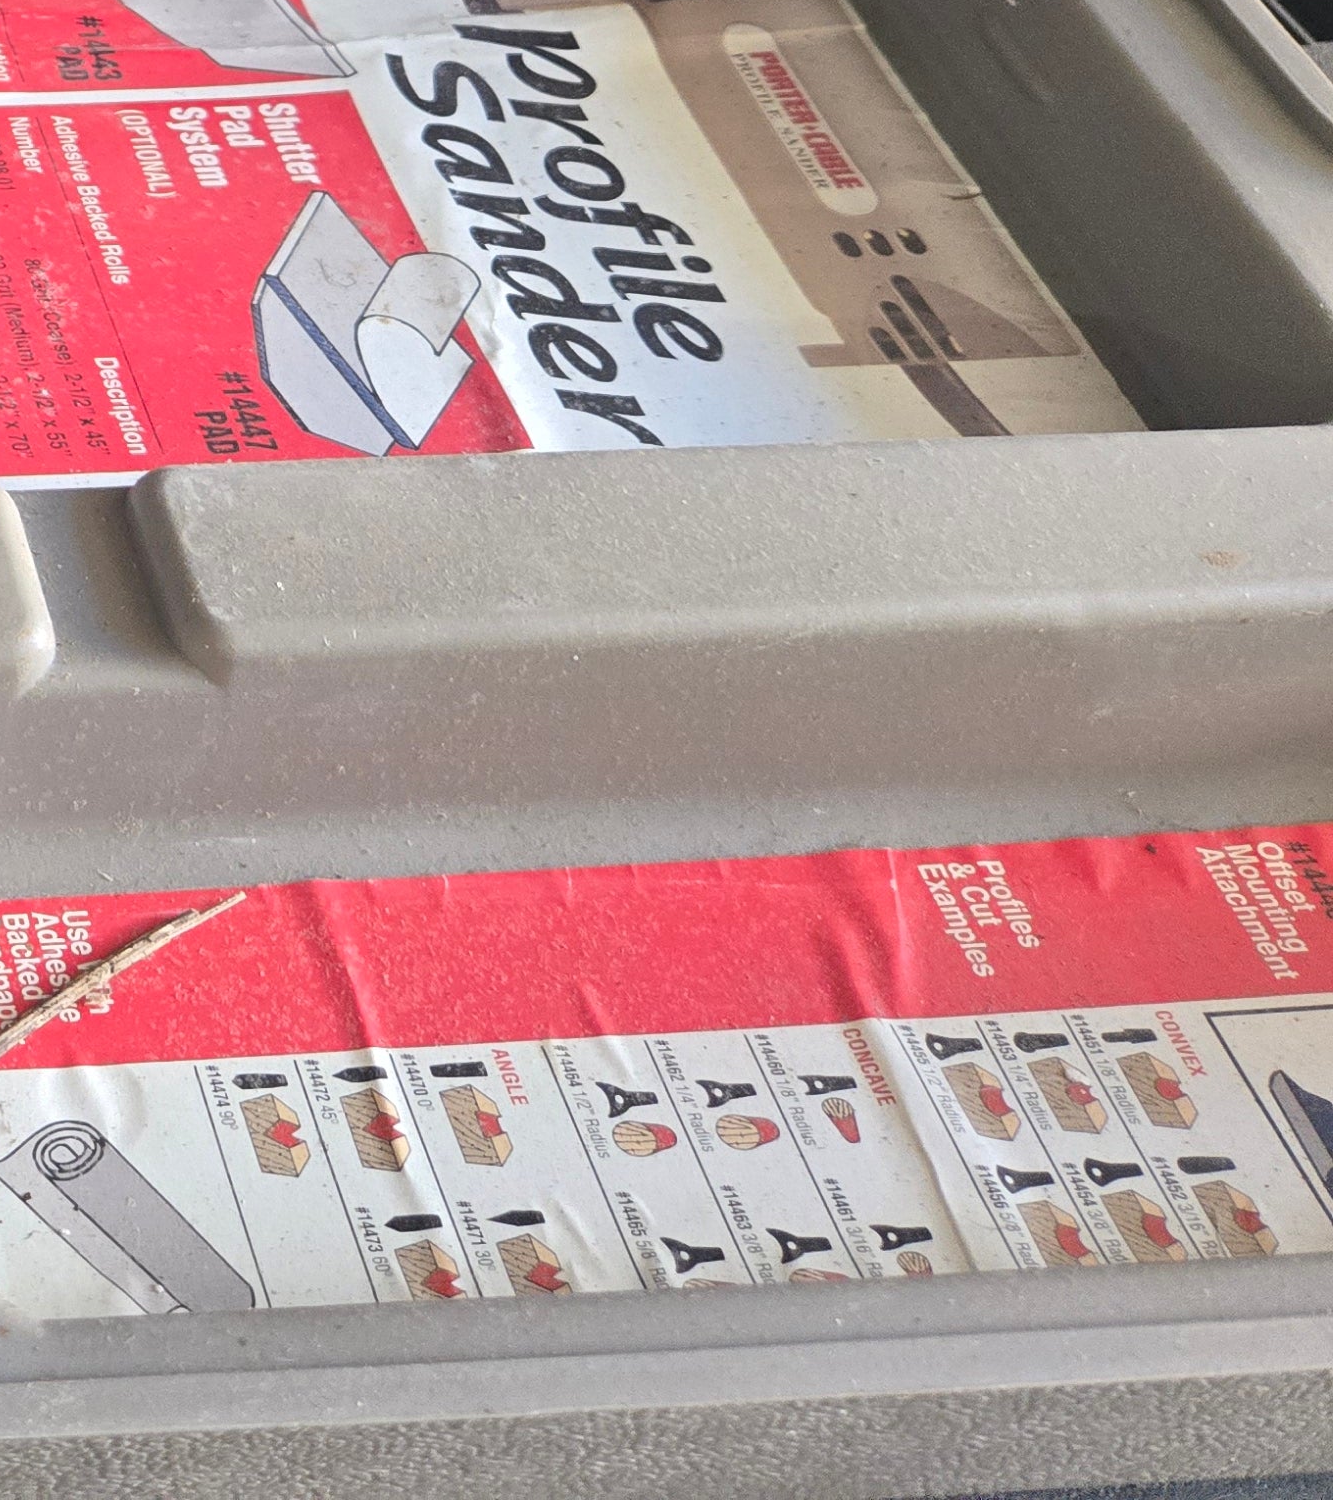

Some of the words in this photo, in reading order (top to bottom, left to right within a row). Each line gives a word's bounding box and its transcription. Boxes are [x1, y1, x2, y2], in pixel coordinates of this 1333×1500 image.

[51, 46, 89, 81] PAD
[78, 15, 123, 81] #14443
[212, 105, 264, 147] Pad
[732, 53, 782, 120] PROFILE
[782, 127, 830, 189] SANDER
[749, 50, 819, 124] PORTER
[802, 132, 864, 189] CABLE
[7, 116, 45, 173] Number
[113, 108, 177, 197] (OPTIONAL)
[159, 106, 235, 187] System
[258, 102, 321, 185] Shutter
[49, 115, 93, 181] Adhesive
[75, 184, 116, 240] Backed
[97, 244, 133, 285] Rolls
[451, 23, 727, 362] Profile
[386, 53, 665, 447] Sander
[94, 356, 147, 455] Description
[214, 371, 277, 450] #14447
[193, 410, 241, 453] PAD
[944, 861, 980, 879] &
[1257, 841, 1316, 912] Offset
[917, 863, 995, 978] Examples
[957, 885, 1005, 927] Cut
[977, 858, 1040, 949] Profiles
[1195, 846, 1300, 980] Attachment
[1224, 844, 1309, 953] Mounting
[62, 910, 93, 956] Use
[2, 913, 50, 1000] Backed
[32, 912, 81, 1022] Adhese
[551, 1045, 583, 1087] #14464
[653, 1039, 685, 1081] #14462
[752, 1033, 786, 1075] #14460
[1153, 1010, 1207, 1076] CONVEX
[203, 1064, 230, 1107] #14474
[301, 1059, 330, 1101] #14472
[399, 1053, 429, 1095] #14470
[491, 1048, 528, 1105] ANGLE
[841, 1028, 897, 1106] CONCAVE
[896, 1024, 930, 1064] #14455
[920, 1068, 946, 1092] 1/2"
[934, 1094, 968, 1132] Radius
[981, 1020, 1018, 1061] #14453
[1006, 1065, 1033, 1088] 1/4"
[1020, 1091, 1056, 1129] Radius
[1068, 1014, 1104, 1054] #14451
[1093, 1059, 1121, 1082] 1/8"
[1108, 1085, 1144, 1124] Radius
[571, 1091, 595, 1114] 1/2"
[673, 1085, 698, 1109] 1/4"
[774, 1079, 800, 1103] 1/8"
[582, 1118, 613, 1158] Radius
[685, 1112, 718, 1151] Radius
[786, 1106, 819, 1145] Radius
[821, 1178, 856, 1222] #14461
[971, 1164, 1009, 1208] #14456
[1058, 1162, 1097, 1206] #14454
[1148, 1155, 1188, 1200] #14452
[352, 1207, 383, 1252] #14473
[453, 1200, 486, 1246] #14471
[613, 1191, 648, 1236] #14465
[717, 1184, 753, 1230] #14463
